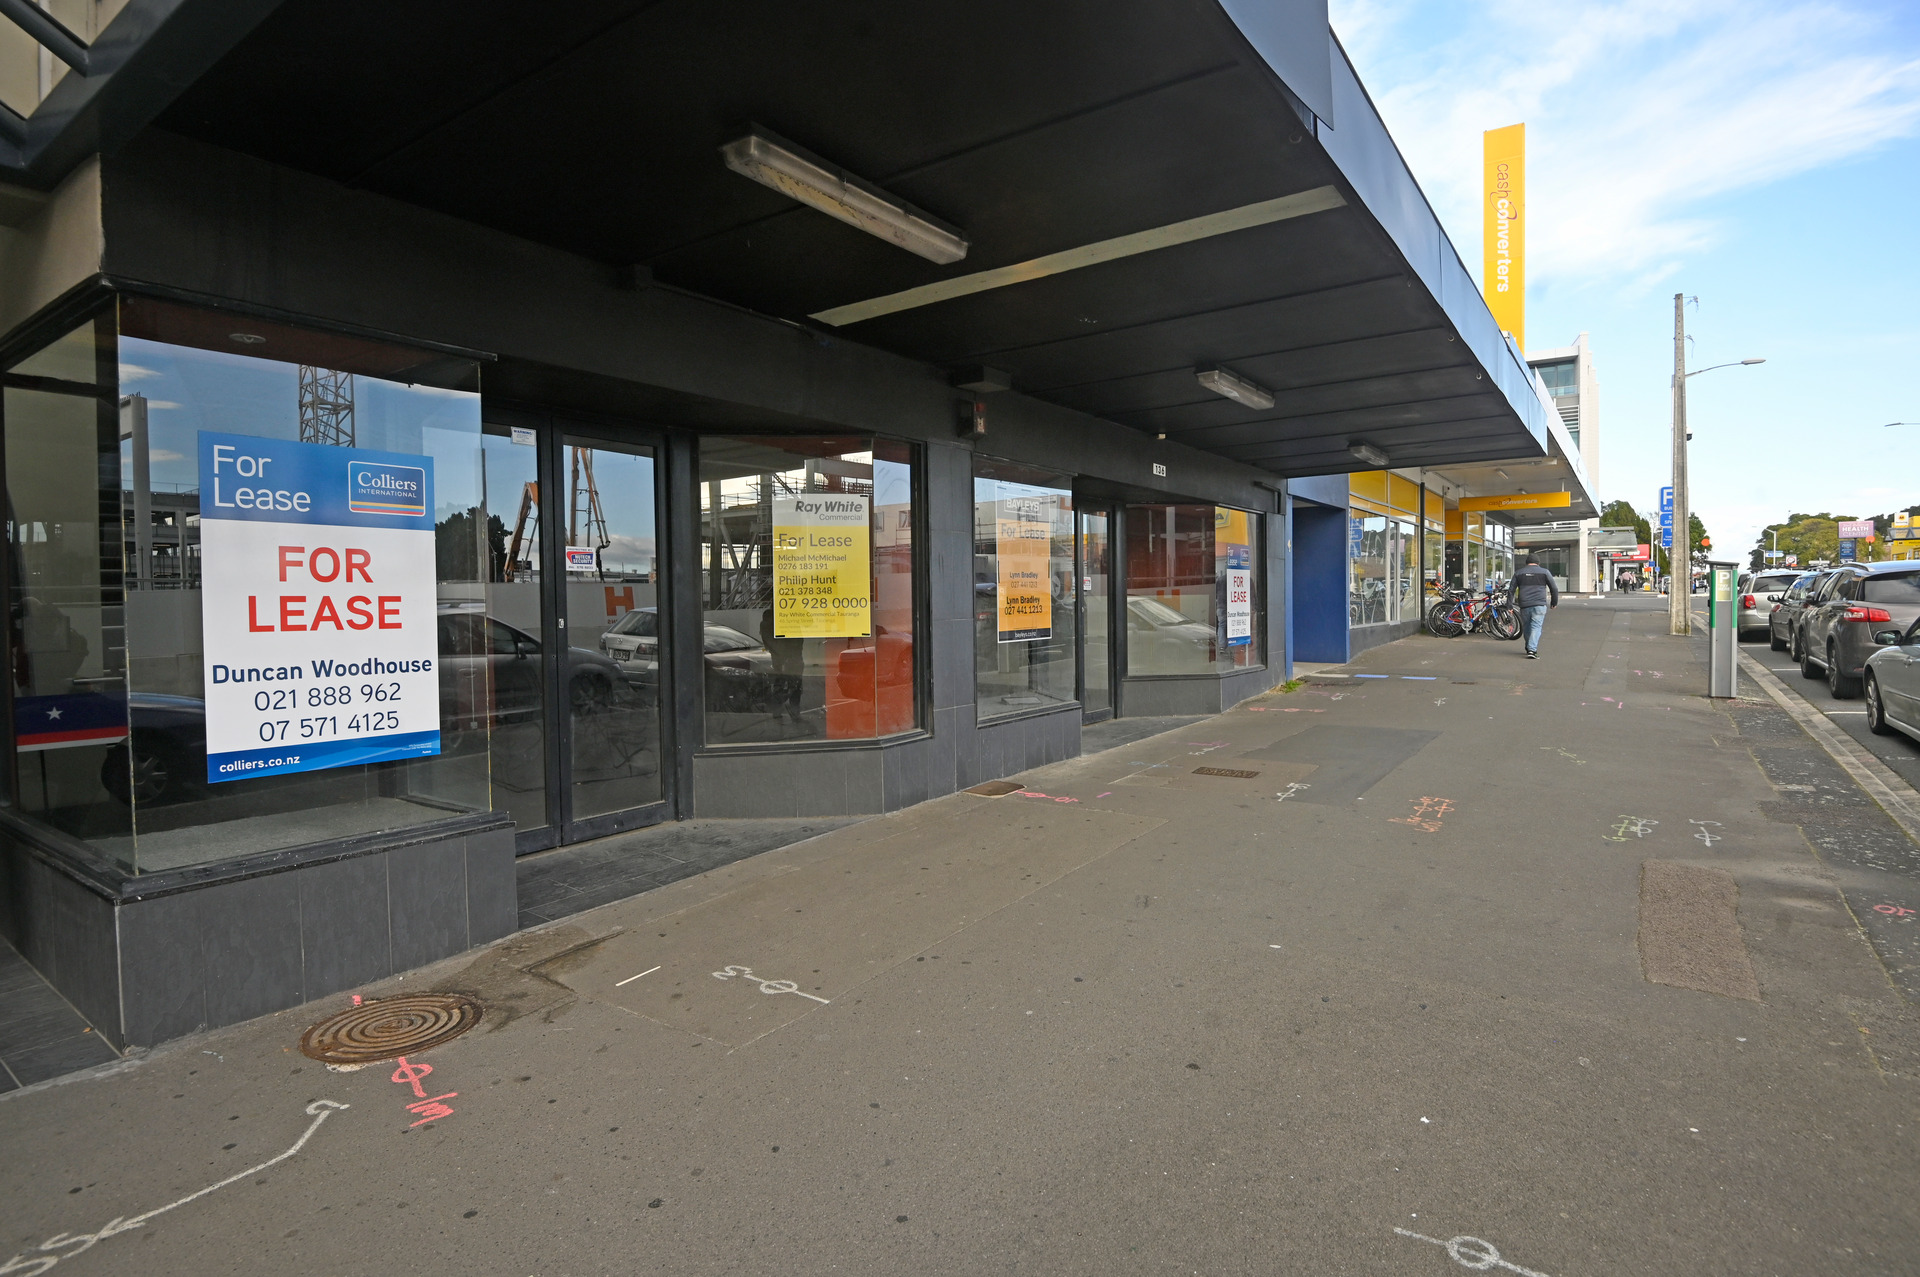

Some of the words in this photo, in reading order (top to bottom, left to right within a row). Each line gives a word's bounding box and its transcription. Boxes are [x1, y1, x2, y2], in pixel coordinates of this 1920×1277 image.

[1497, 163, 1512, 199] cash
[1497, 199, 1512, 293] converters
[213, 444, 272, 478] For
[357, 471, 417, 491] Colliers
[214, 477, 311, 512] Lease
[358, 488, 417, 498] INTERNATIONAL
[795, 501, 822, 514] Ray
[824, 501, 863, 513] White
[1006, 498, 1040, 511] BAYLEYS
[1001, 523, 1016, 537] For
[1019, 525, 1045, 540] Lease
[778, 533, 804, 547] For
[809, 533, 852, 547] Lease
[278, 545, 374, 583] FOR
[779, 576, 808, 586] Philip
[811, 575, 837, 584] Hunt
[1021, 571, 1038, 579] Bradley
[1233, 576, 1244, 588] FOR
[1719, 572, 1730, 583] P
[778, 588, 795, 596] 021
[797, 587, 814, 595] 378
[816, 587, 833, 595] 348
[1231, 591, 1247, 603] LEASE
[779, 598, 797, 609] 07
[801, 598, 828, 609] 928
[832, 597, 868, 609] 0000
[1006, 596, 1019, 606] Lynn
[1020, 595, 1040, 605] Bradley
[248, 595, 402, 633] LEASE
[1005, 606, 1015, 615] 027
[1017, 605, 1028, 614] 441
[1029, 605, 1043, 614] 1213
[212, 664, 303, 684] Duncan
[311, 658, 432, 679] Woodhouse
[254, 689, 297, 711] 021
[308, 686, 351, 707] 888
[360, 682, 402, 703] 962
[259, 720, 290, 742] 07
[300, 716, 337, 738] 571
[348, 711, 399, 733] 4125
[219, 755, 300, 772] colliers.co.nz
